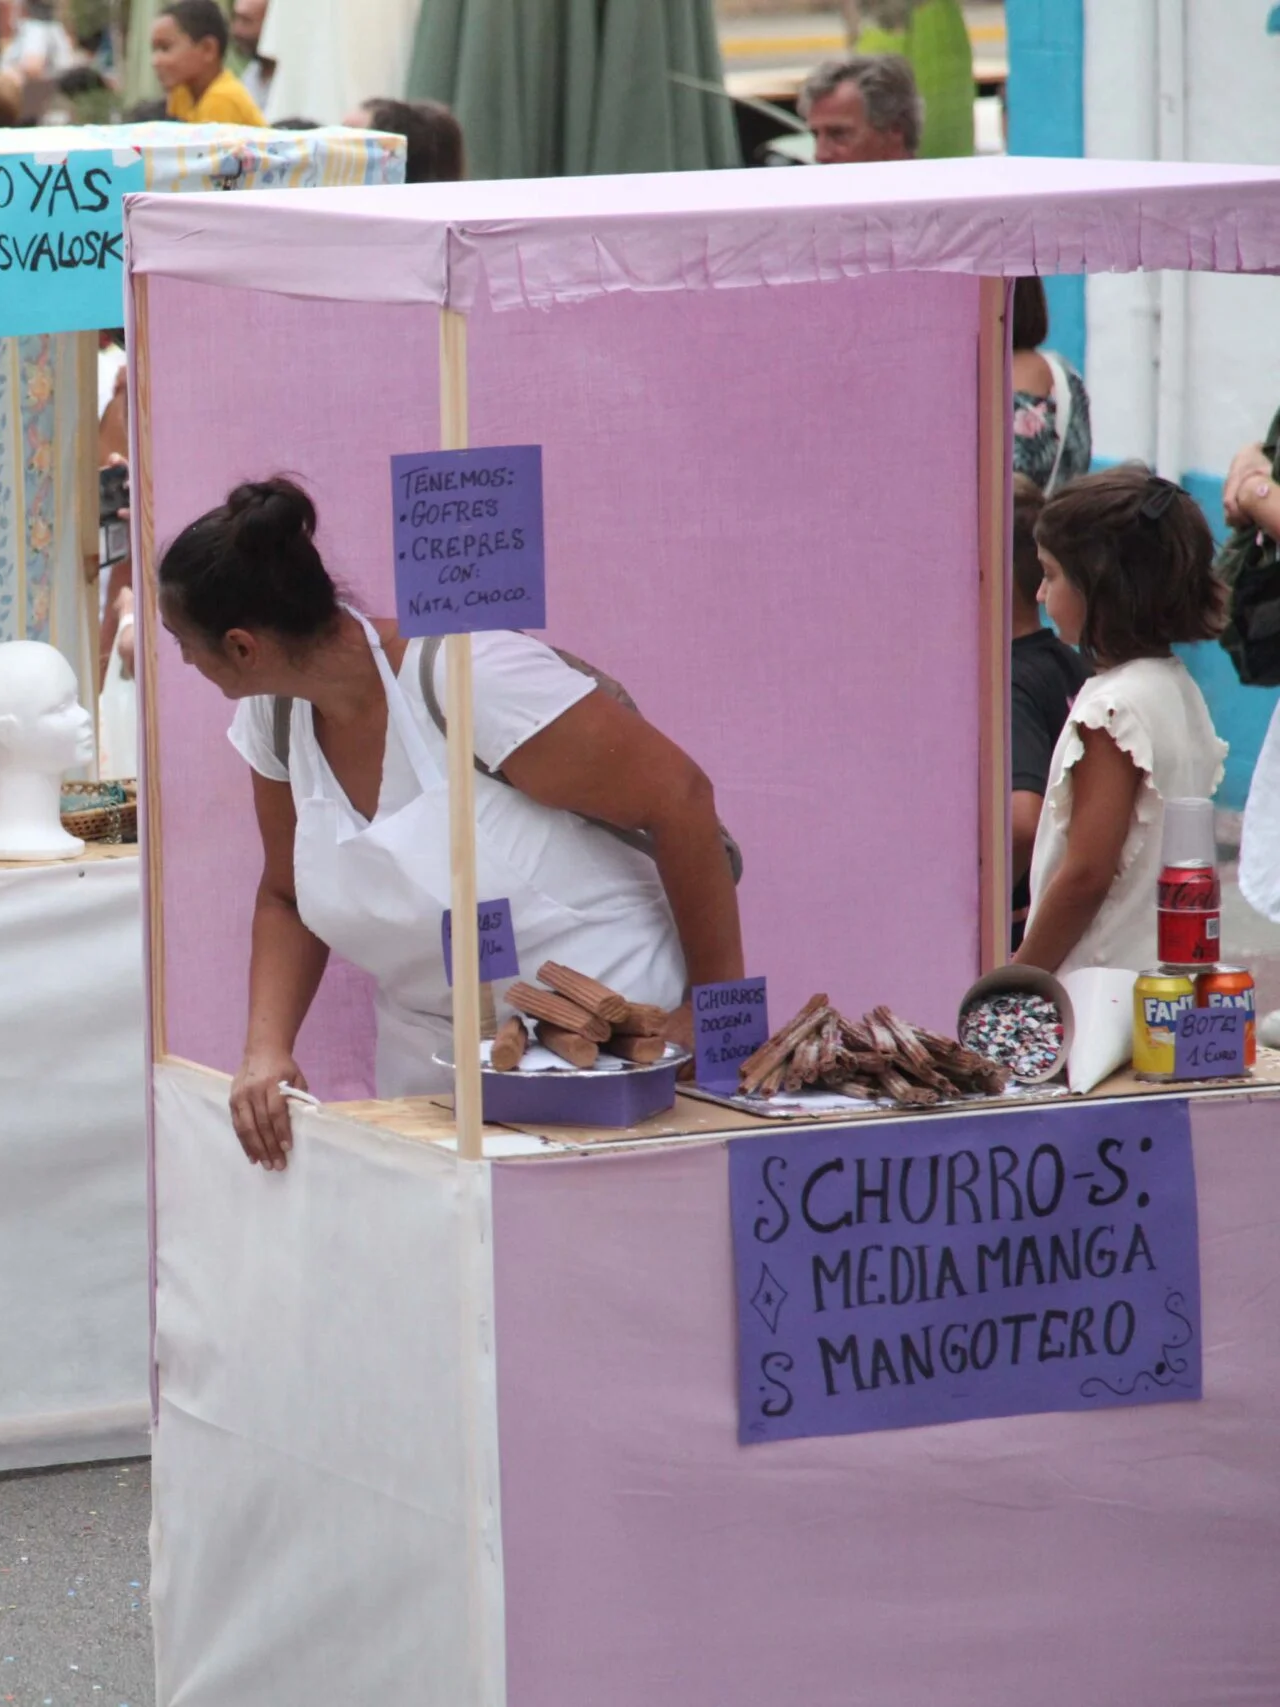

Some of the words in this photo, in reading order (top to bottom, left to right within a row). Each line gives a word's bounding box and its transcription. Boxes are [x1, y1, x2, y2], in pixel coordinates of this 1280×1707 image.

[399, 466, 516, 500] TENEMOS:
[410, 498, 500, 528] GOFRES
[411, 527, 526, 562] CREPRES
[696, 987, 765, 1012] CHURROS
[1180, 1014, 1237, 1038] BOTE
[1185, 1043, 1200, 1067] 1
[816, 1299, 1137, 1397] MANGOTERO
